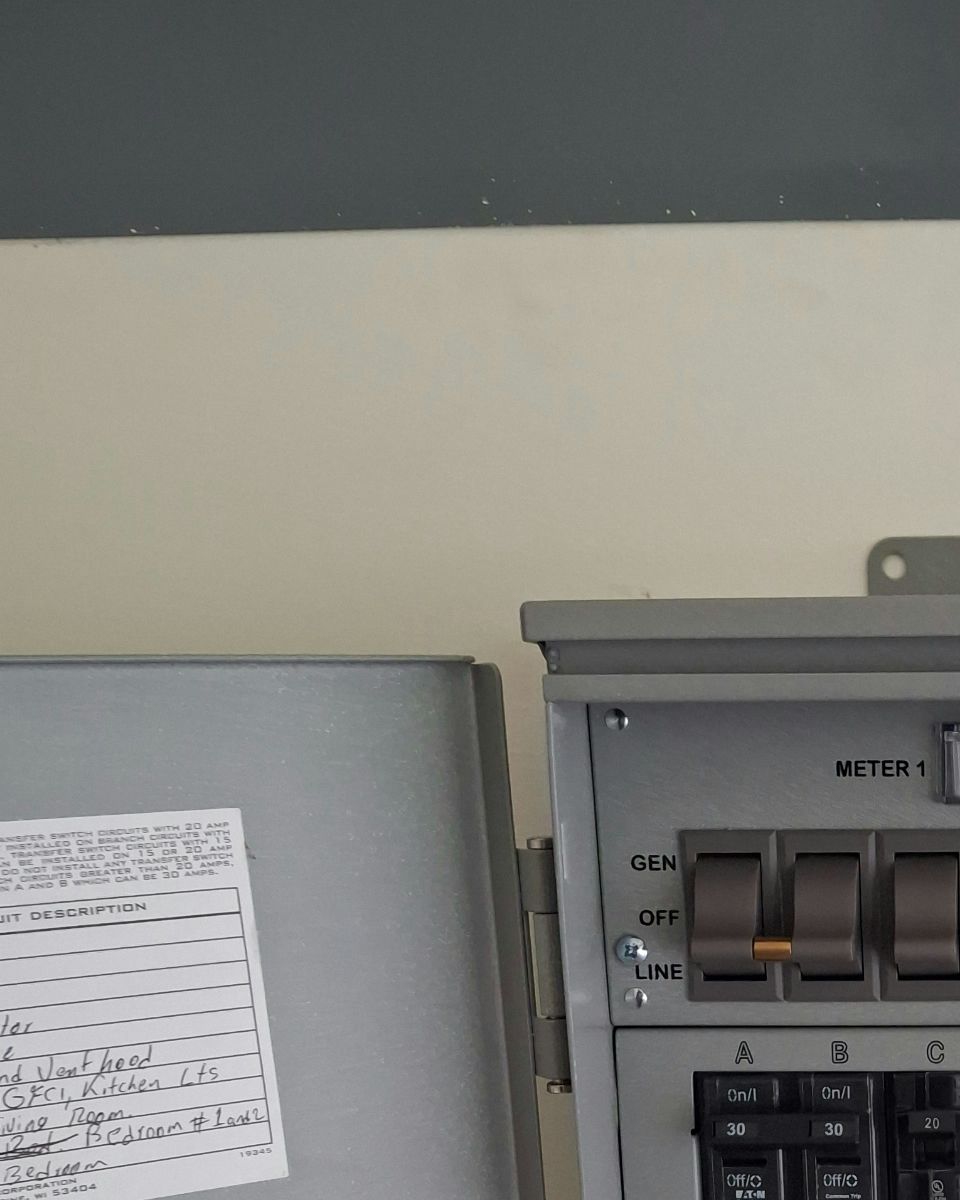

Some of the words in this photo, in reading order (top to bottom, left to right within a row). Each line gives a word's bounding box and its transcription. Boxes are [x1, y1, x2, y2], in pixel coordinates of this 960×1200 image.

[836, 760, 909, 777] METER
[916, 760, 925, 777] 1
[50, 831, 93, 840] SWITCH
[98, 827, 149, 836] CIRCUITS
[185, 822, 202, 831] 20
[206, 821, 229, 829] AMP
[6, 840, 71, 851] INSTALLED
[76, 838, 93, 846] ON
[98, 835, 145, 844] BRANCH
[149, 831, 200, 841] CIRCUITS
[10, 848, 72, 858] TRANSFER
[78, 845, 120, 854] SWITCH
[126, 840, 177, 850] CIRCUITS
[41, 853, 105, 864] INSTALLED
[139, 849, 154, 857] 15
[185, 845, 202, 853] 20
[630, 854, 676, 871] GEN
[1, 868, 19, 876] DO
[52, 862, 100, 871] INSTALL
[130, 855, 188, 865] TRANSFER
[193, 853, 234, 861] SWITCH
[20, 872, 73, 882] CIRCUITS
[80, 867, 131, 877] GREATER
[138, 864, 168, 872] THAN
[176, 861, 193, 870] 20
[15, 883, 24, 891] A
[28, 881, 54, 890] AND
[59, 879, 68, 887] B
[73, 877, 111, 886] WHICH
[115, 875, 138, 883] CAN
[30, 902, 147, 920] DESCRIPTION
[639, 909, 679, 926] OFF
[635, 963, 683, 980] LINE
[735, 1041, 754, 1064] A
[831, 1041, 849, 1064] B
[926, 1041, 945, 1064] C
[82, 1073, 160, 1097] Kitchen
[726, 1122, 746, 1136] 30
[824, 1122, 843, 1137] 30
[924, 1117, 940, 1129] 20
[86, 1120, 182, 1147] Bedroom
[240, 1147, 272, 1158] 19345
[53, 1183, 97, 1197] 53404
